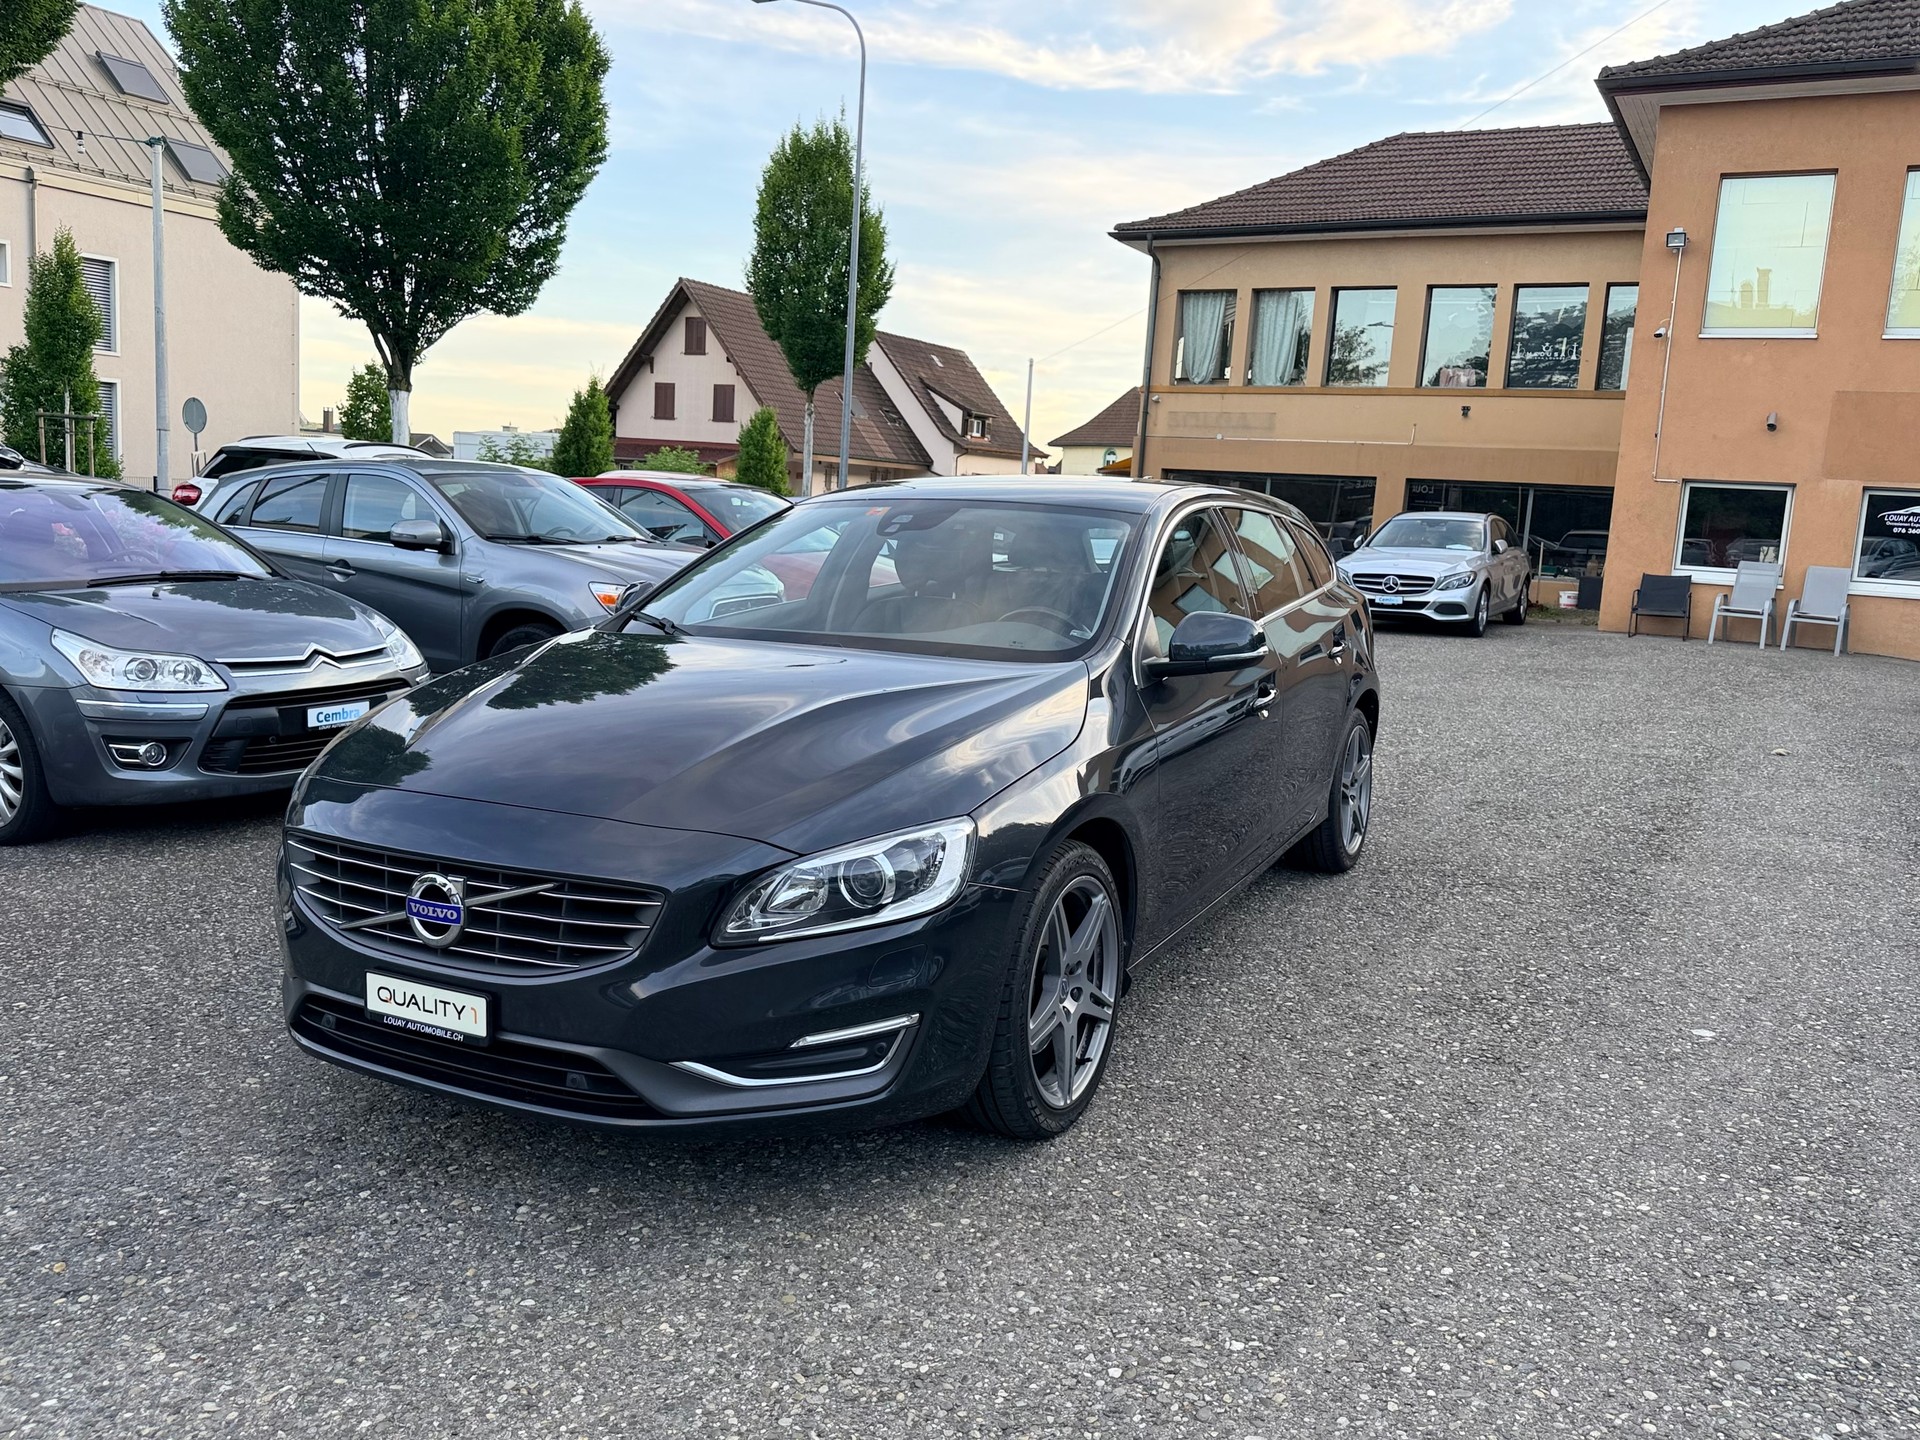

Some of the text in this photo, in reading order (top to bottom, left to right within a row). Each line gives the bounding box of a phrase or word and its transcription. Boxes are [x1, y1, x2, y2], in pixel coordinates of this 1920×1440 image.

[1884, 514, 1908, 522] LOUAY
[316, 707, 360, 723] Cembra
[409, 902, 458, 920] VOLVO
[383, 1015, 464, 1042] LOUAY AUTOMOBILE.CH
